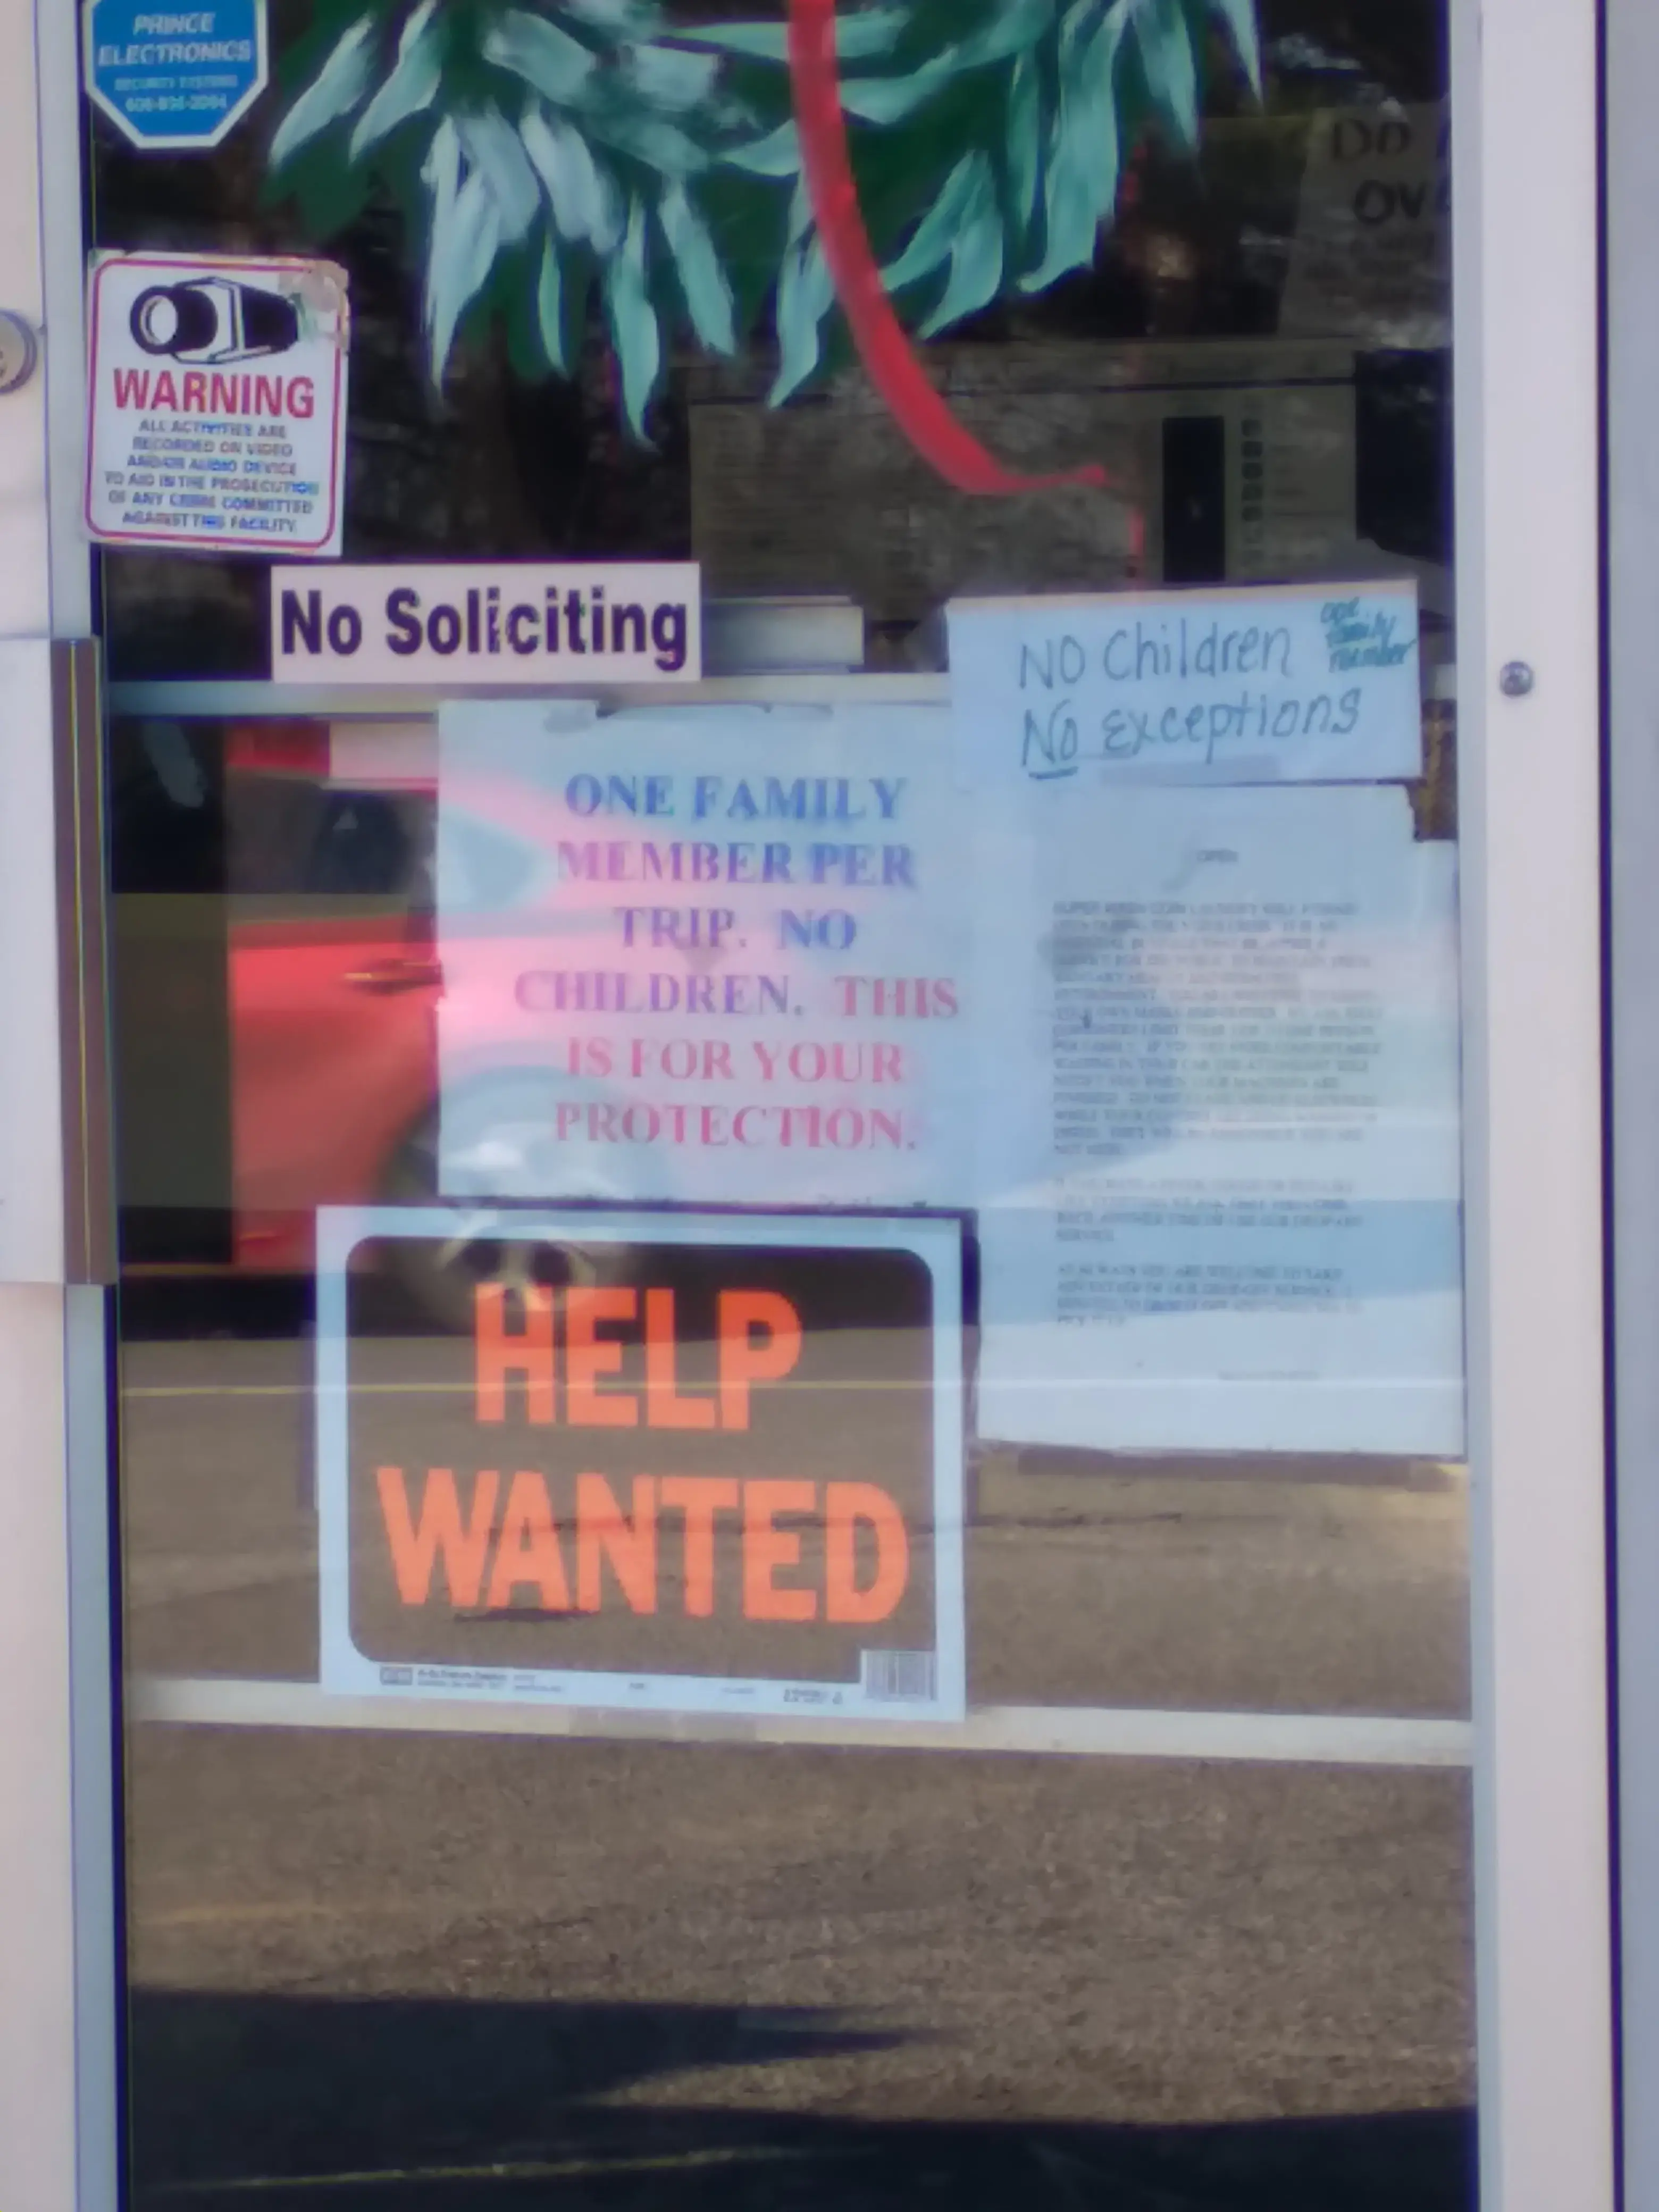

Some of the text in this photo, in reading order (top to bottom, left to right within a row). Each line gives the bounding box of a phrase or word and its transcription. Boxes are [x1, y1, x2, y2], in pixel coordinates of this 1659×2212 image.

[133, 12, 215, 35] PRINCE
[98, 39, 251, 66] ELECTRONICS
[113, 368, 314, 418] WARNING
[132, 437, 294, 457] RECORDED ON VIDEO
[138, 418, 166, 432] ALL
[257, 425, 287, 439] ARE
[104, 471, 125, 485] TO
[128, 473, 155, 487] AID
[178, 475, 206, 489] THE
[189, 458, 237, 472] AUDIO
[243, 460, 297, 476] DEVICE
[108, 489, 127, 504] OF
[132, 491, 163, 505] ANY
[221, 496, 314, 514] COMMITTED
[122, 510, 189, 526] AGAINST
[230, 515, 297, 533] FACILITY
[281, 586, 687, 672] No Soliciting
[1103, 617, 1293, 681] Children
[564, 773, 908, 819] ONE FAMILY
[557, 841, 918, 887] MEMBER PER
[614, 906, 857, 951] TRIP. NO
[514, 970, 959, 1018] CHILDREN. THIS
[567, 1036, 903, 1083] IS FOR YOUR
[556, 1102, 917, 1151] PROTECTION.
[475, 1282, 802, 1430] HELP
[376, 1465, 910, 1623] WANTED
